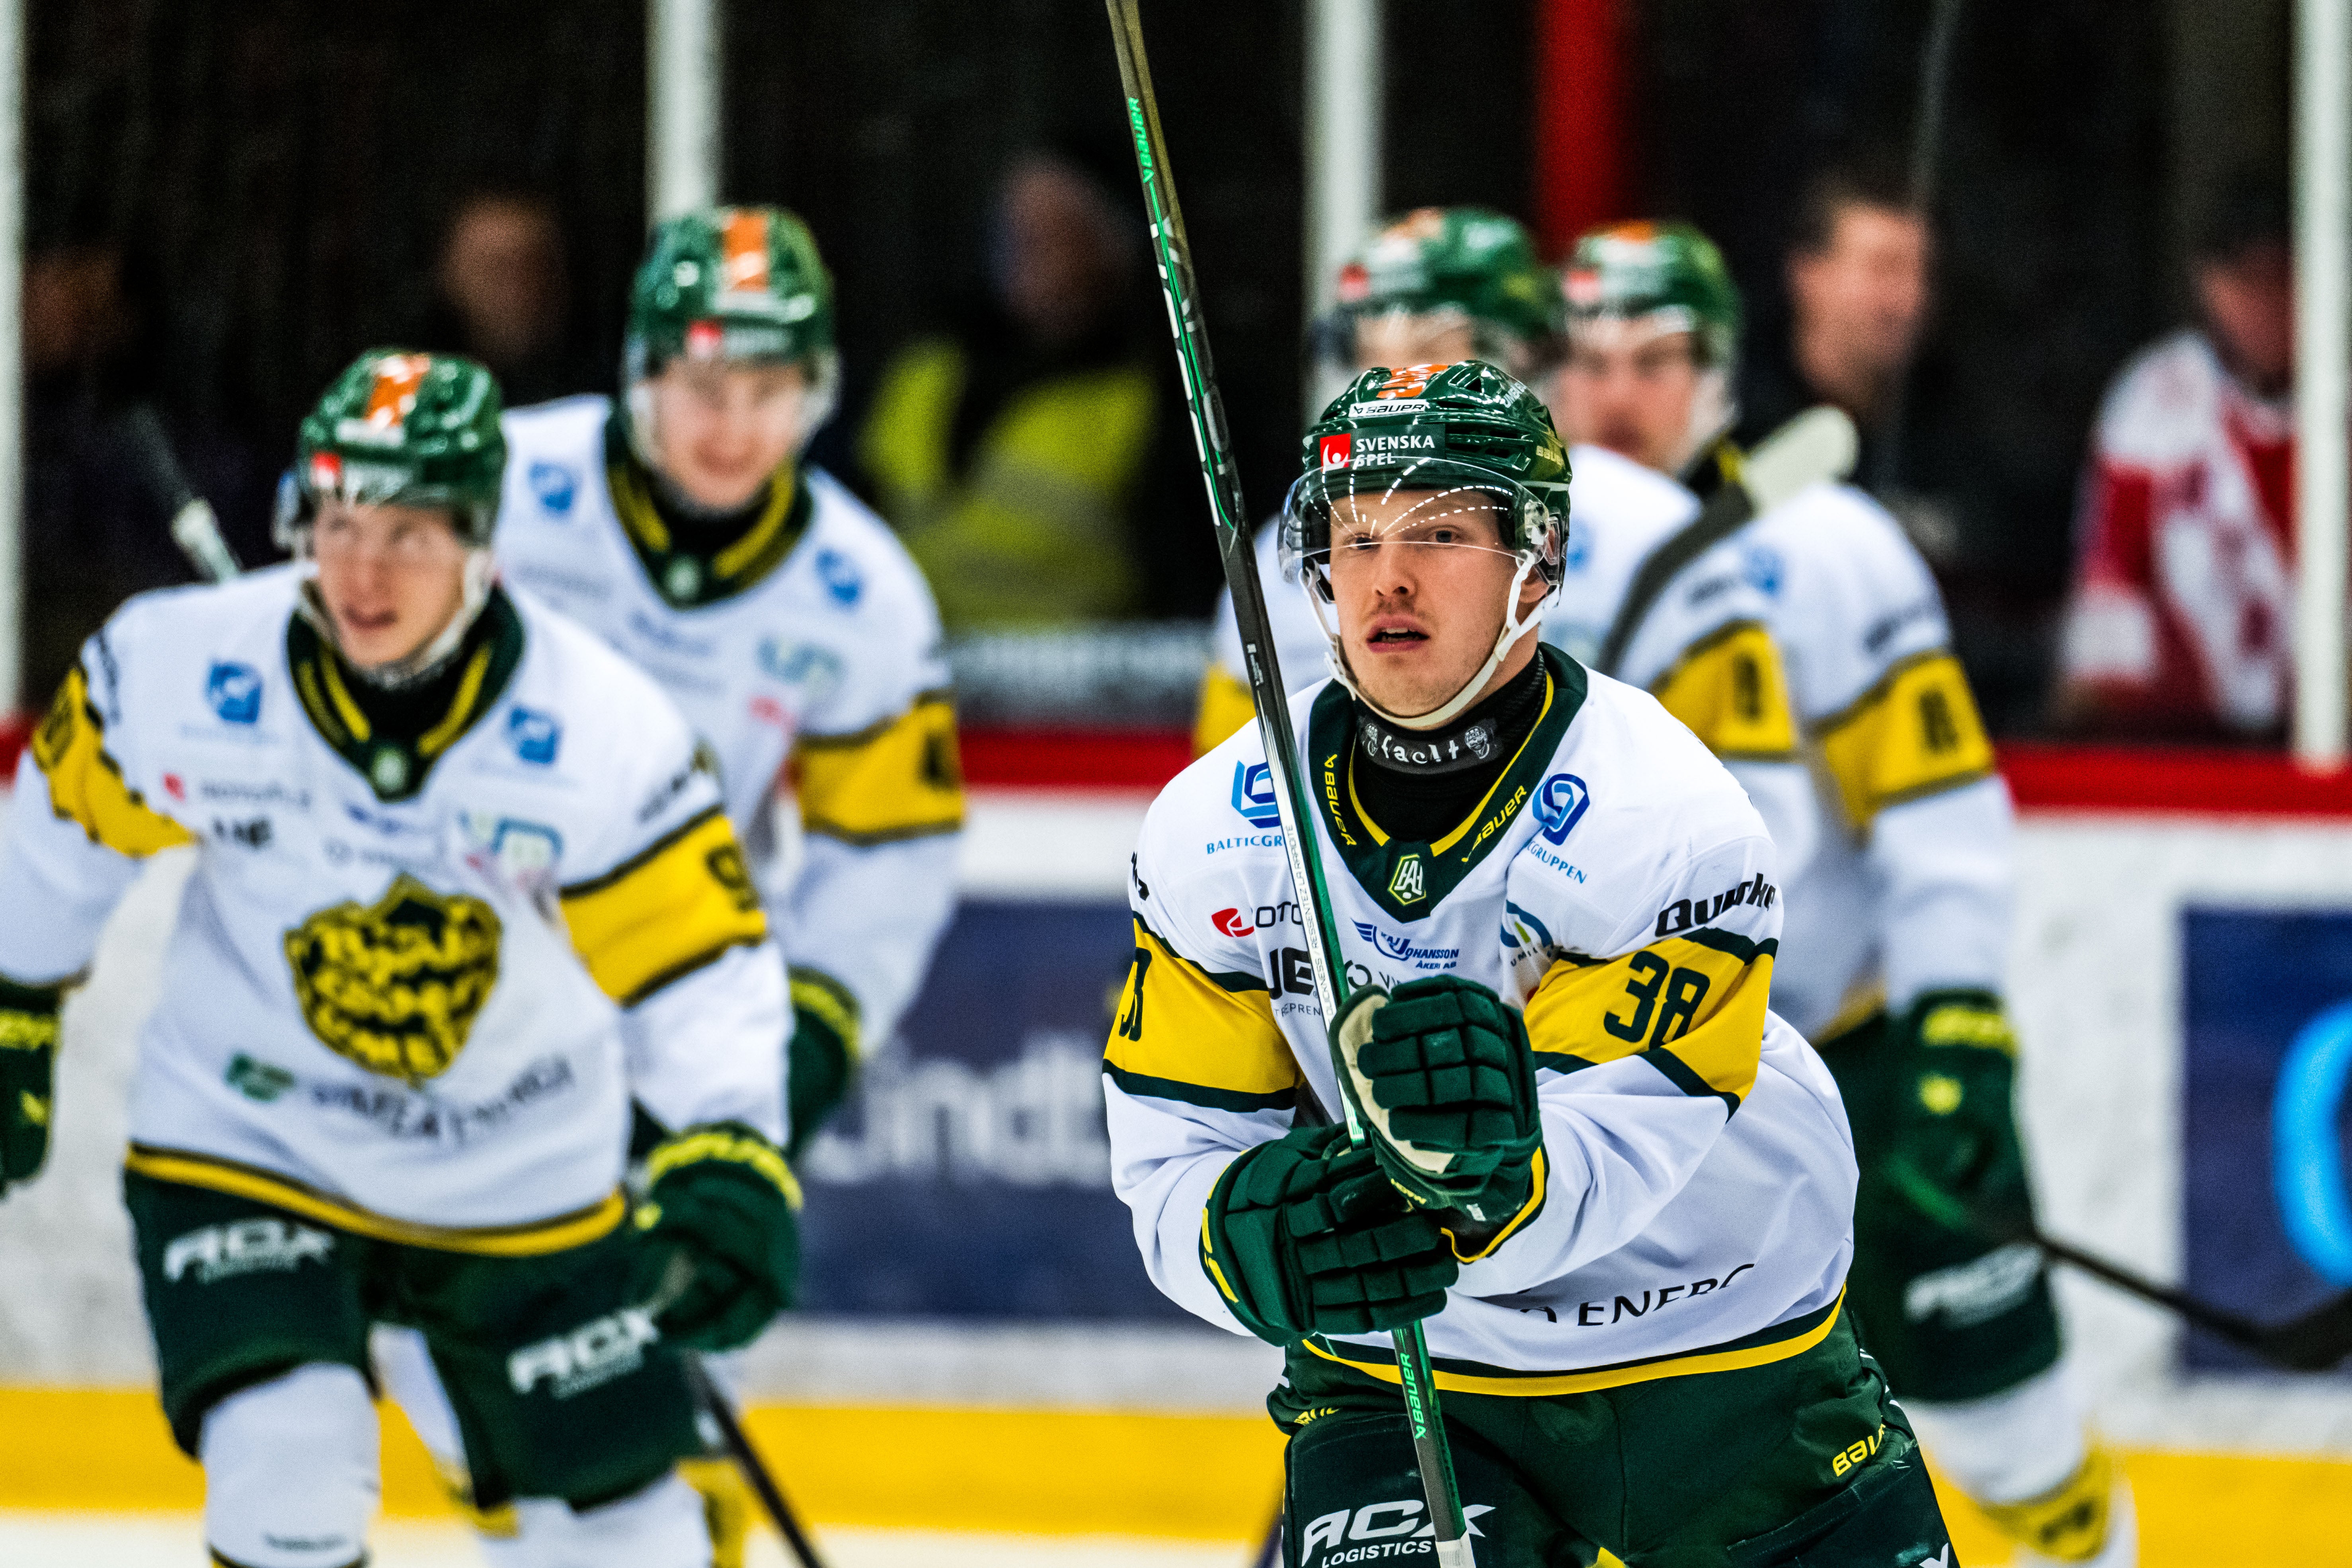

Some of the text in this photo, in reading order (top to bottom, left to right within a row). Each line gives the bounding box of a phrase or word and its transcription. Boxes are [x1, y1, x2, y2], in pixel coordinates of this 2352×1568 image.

[1356, 435, 1435, 452] SVENSKA
[1356, 452, 1396, 467] SPEL
[1324, 772, 1357, 846] BAUER
[1207, 835, 1282, 855] BALTICGR
[1443, 961, 1457, 969] AB
[1603, 951, 1710, 1051] 38
[1400, 1352, 1424, 1424] BAUER
[1832, 1423, 1886, 1477] BAU
[1302, 1500, 1496, 1567] ACX
[1322, 1541, 1432, 1568] LOGISTICS
